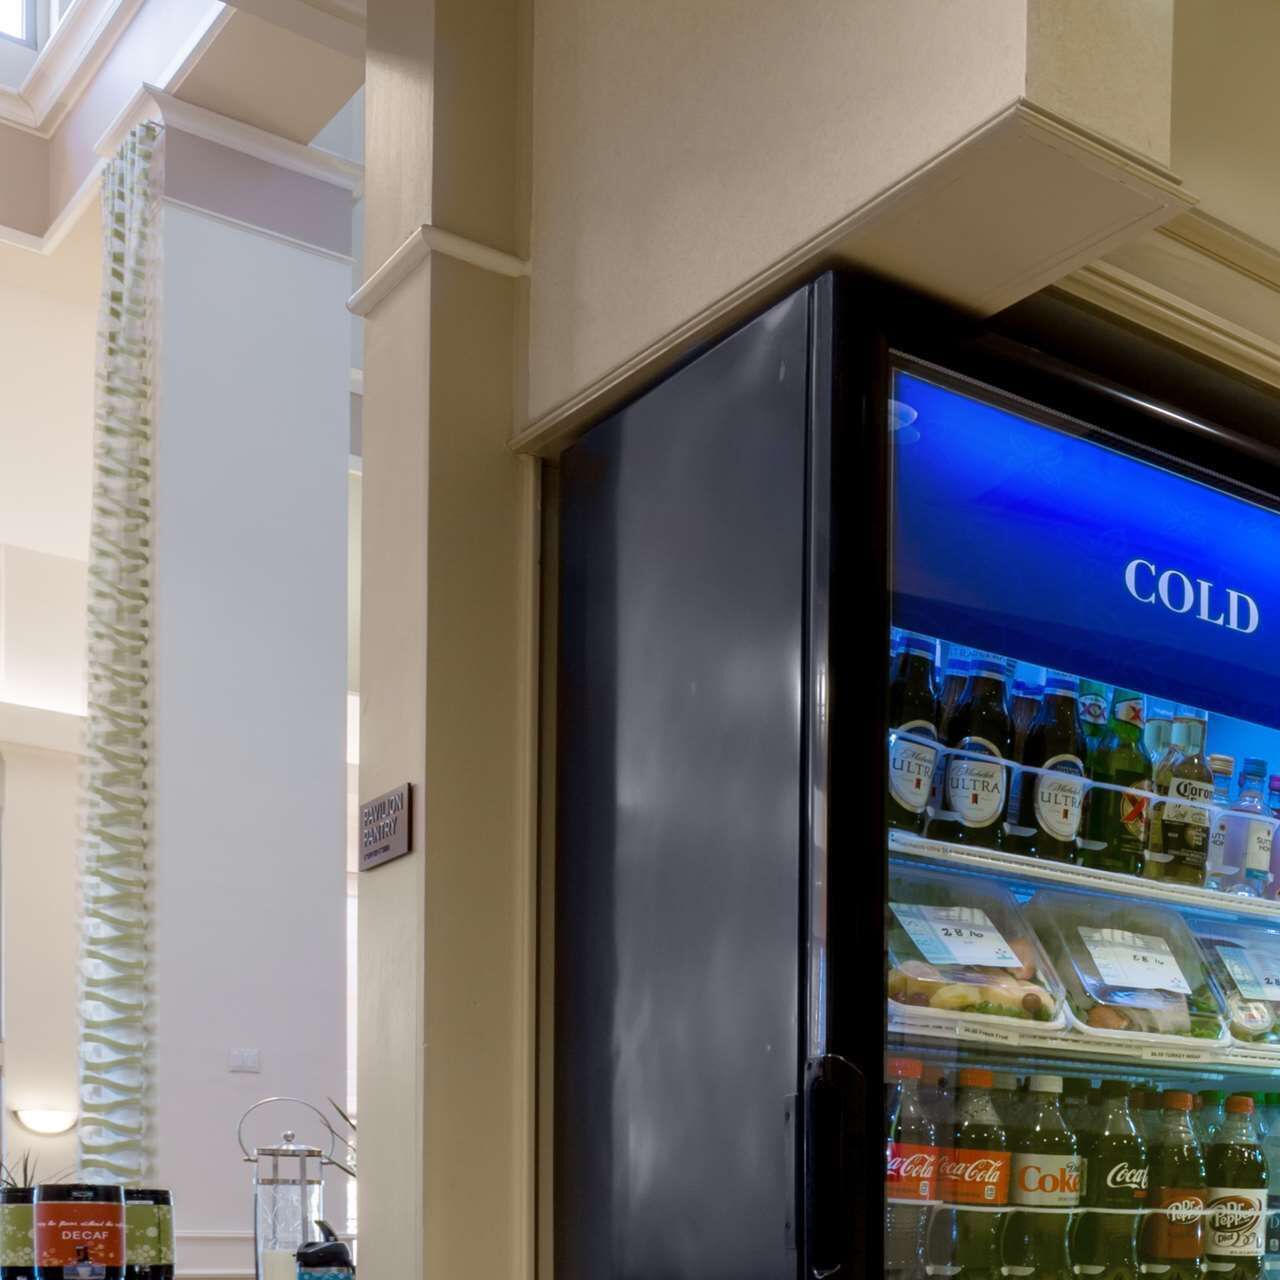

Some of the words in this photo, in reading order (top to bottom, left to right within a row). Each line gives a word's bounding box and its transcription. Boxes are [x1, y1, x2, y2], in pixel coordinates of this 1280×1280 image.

[1124, 558, 1260, 635] COLD
[892, 757, 932, 777] ULTR
[951, 776, 1000, 794] ULTRA
[363, 791, 404, 827] PAVILION
[363, 815, 398, 847] PANTRY
[1018, 1164, 1080, 1193] Coke
[62, 1230, 109, 1240] DECAF
